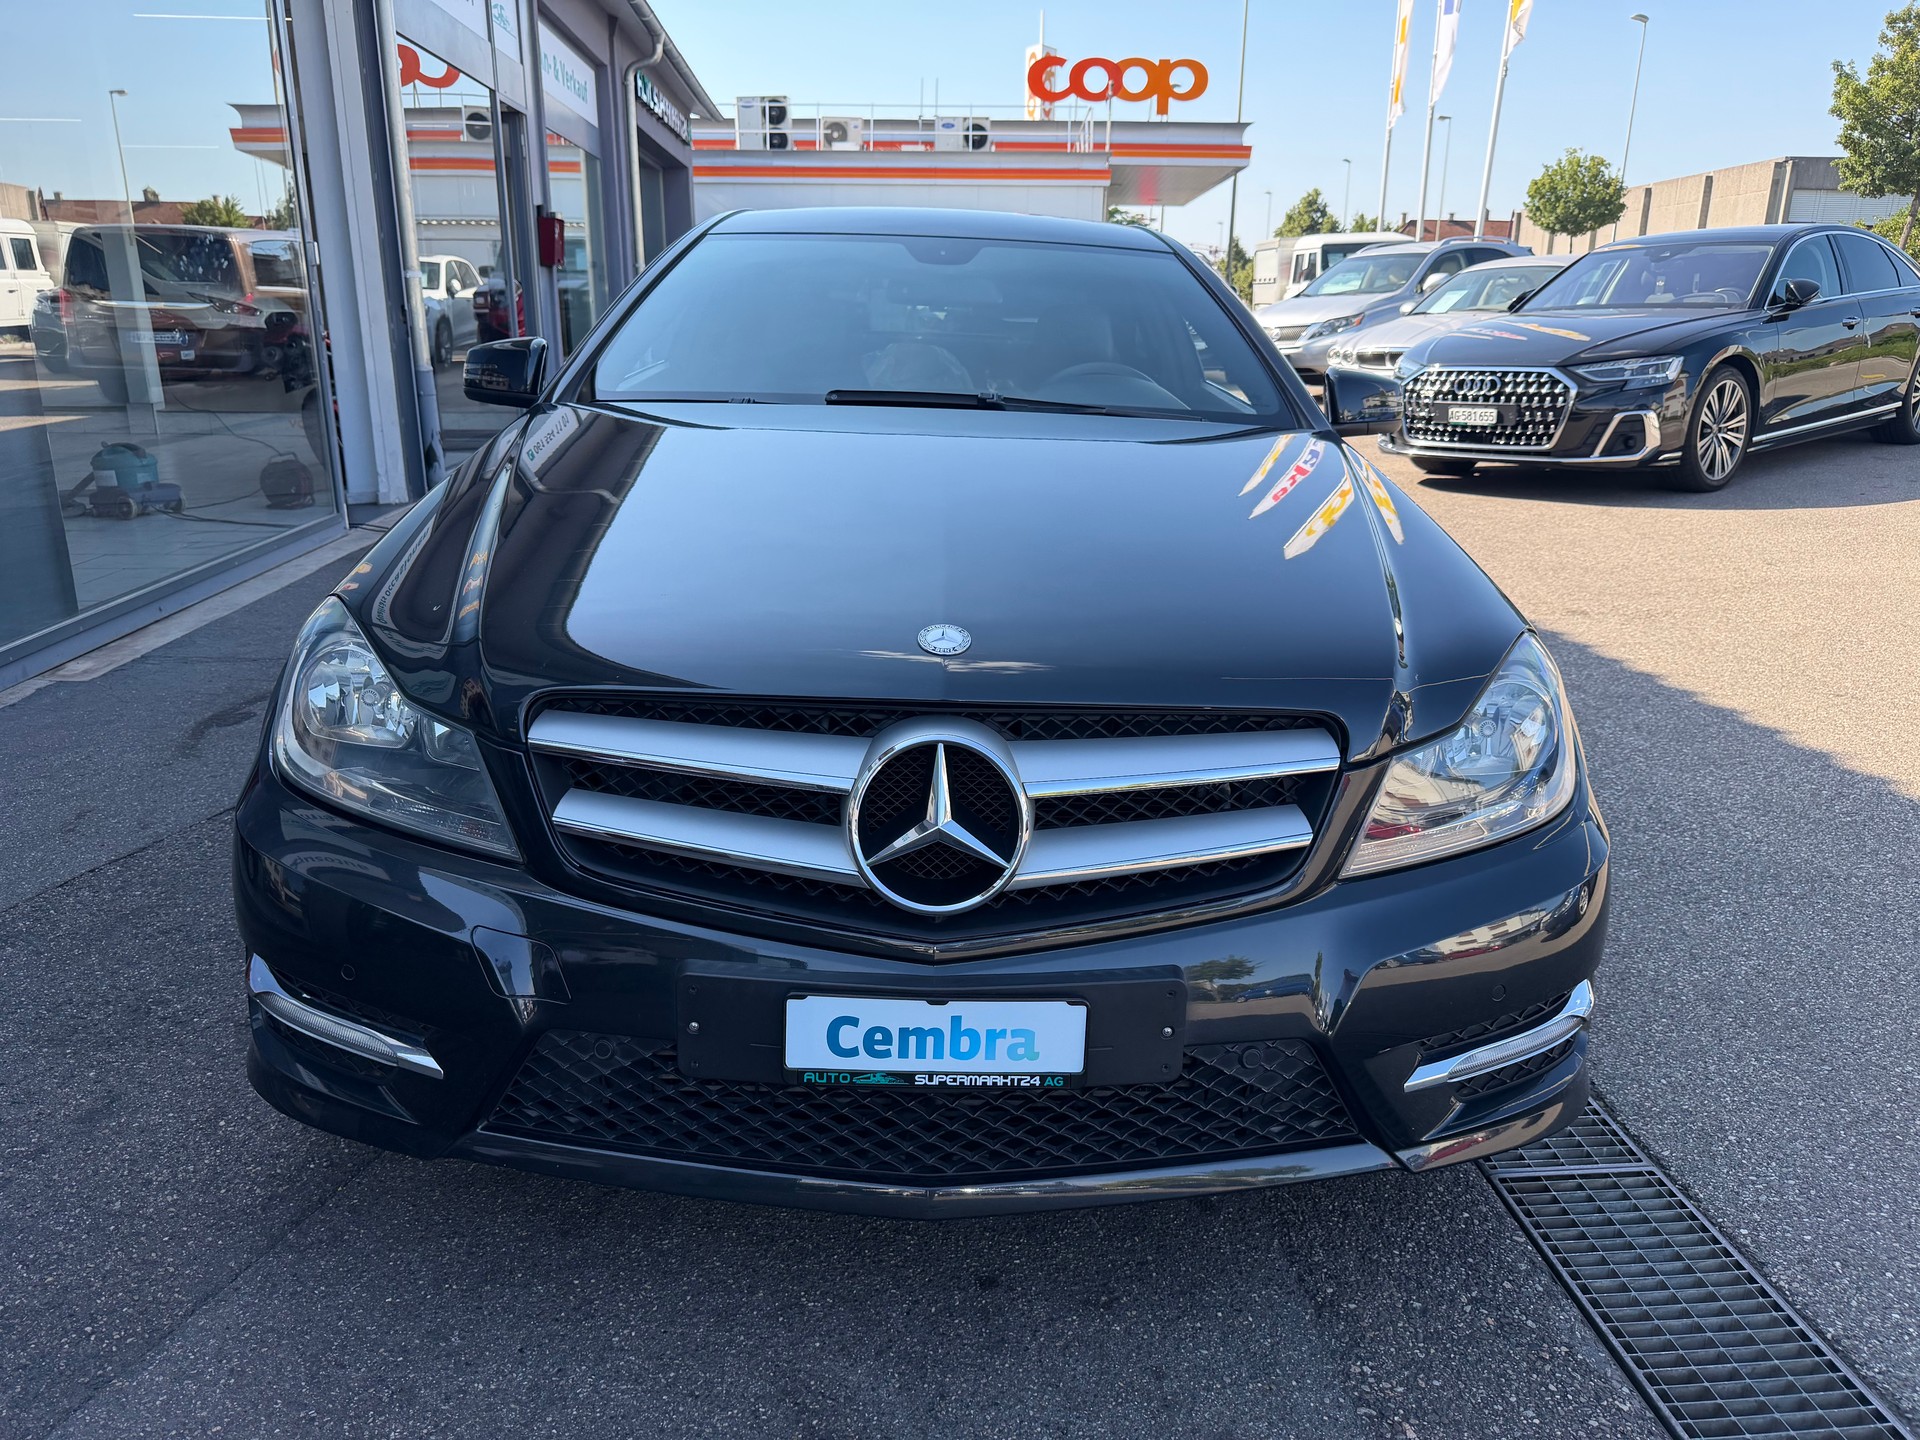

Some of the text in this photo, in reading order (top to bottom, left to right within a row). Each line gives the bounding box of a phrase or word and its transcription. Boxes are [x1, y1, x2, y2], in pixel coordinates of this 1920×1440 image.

[1028, 55, 1208, 115] coop
[826, 1015, 1040, 1062] Cembra
[803, 1072, 1064, 1087] AUTO SUPERMARKT24 AG
